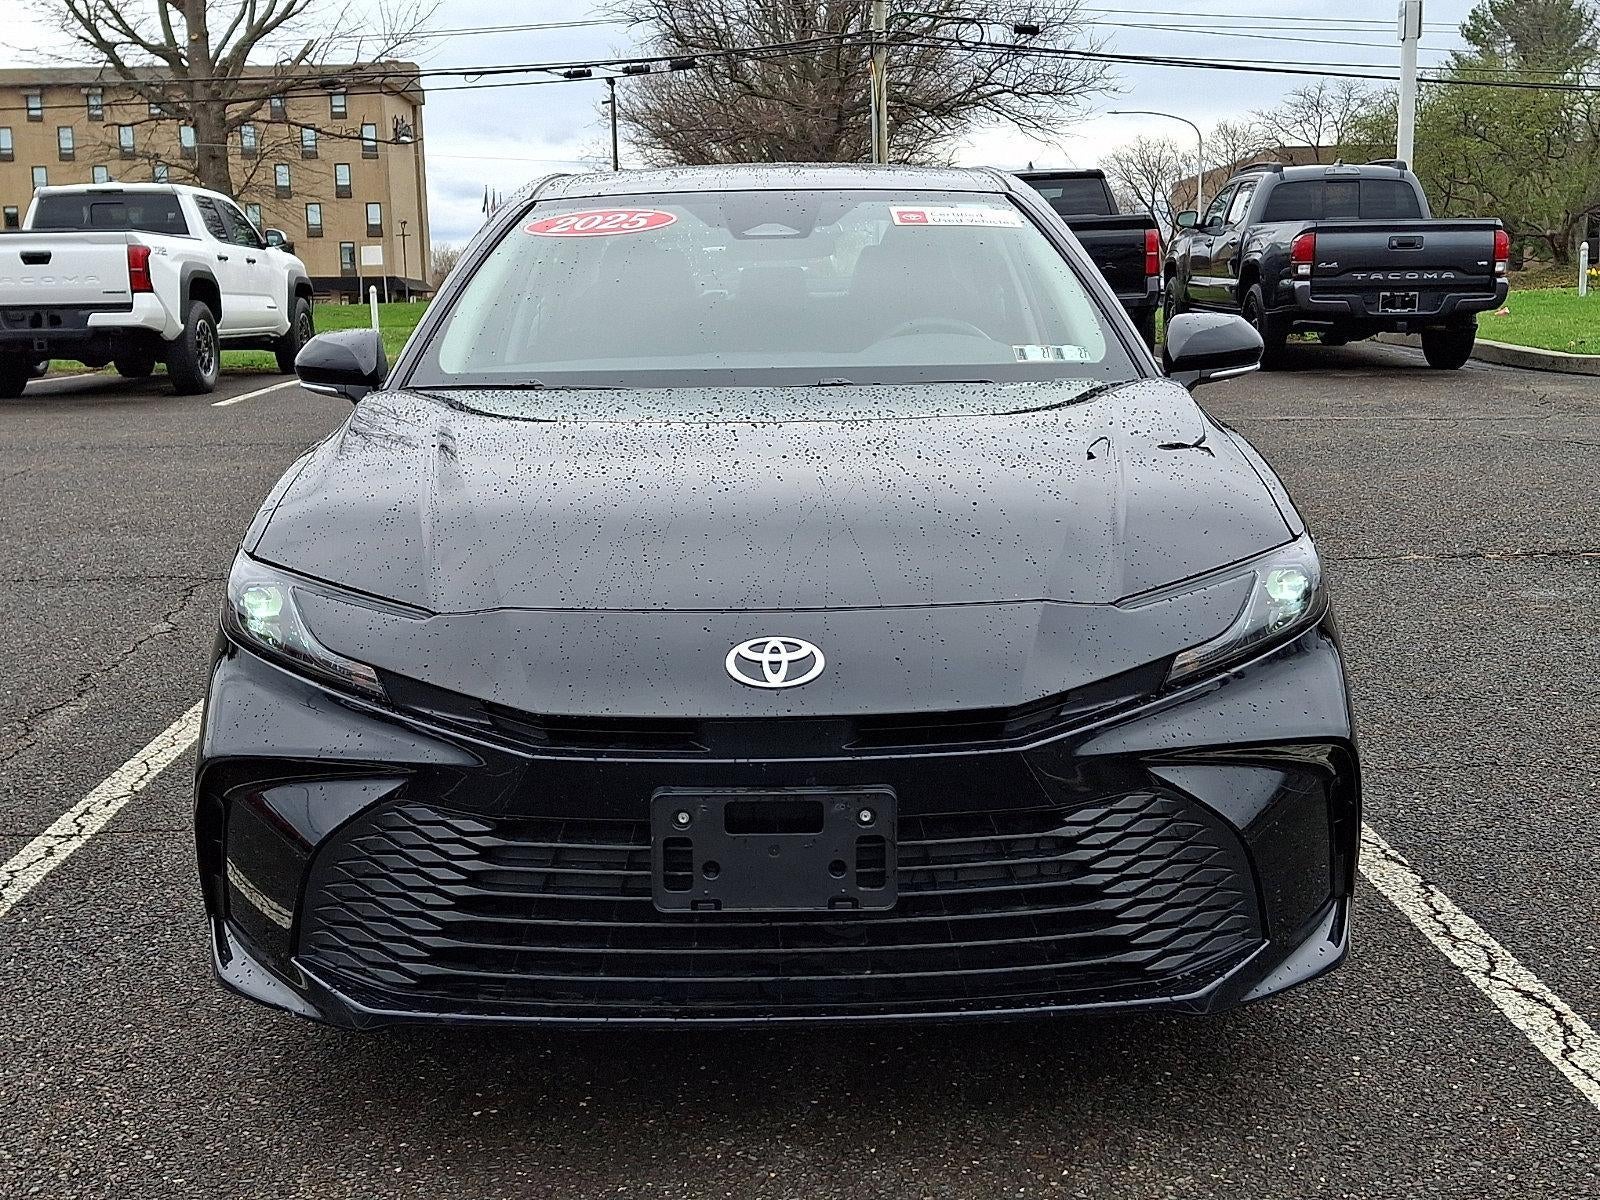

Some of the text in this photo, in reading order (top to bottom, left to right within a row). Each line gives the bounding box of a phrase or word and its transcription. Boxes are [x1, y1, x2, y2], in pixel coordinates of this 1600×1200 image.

[546, 211, 655, 233] 2025
[0, 275, 100, 285] ACOMA
[1352, 272, 1455, 280] TACOMA
